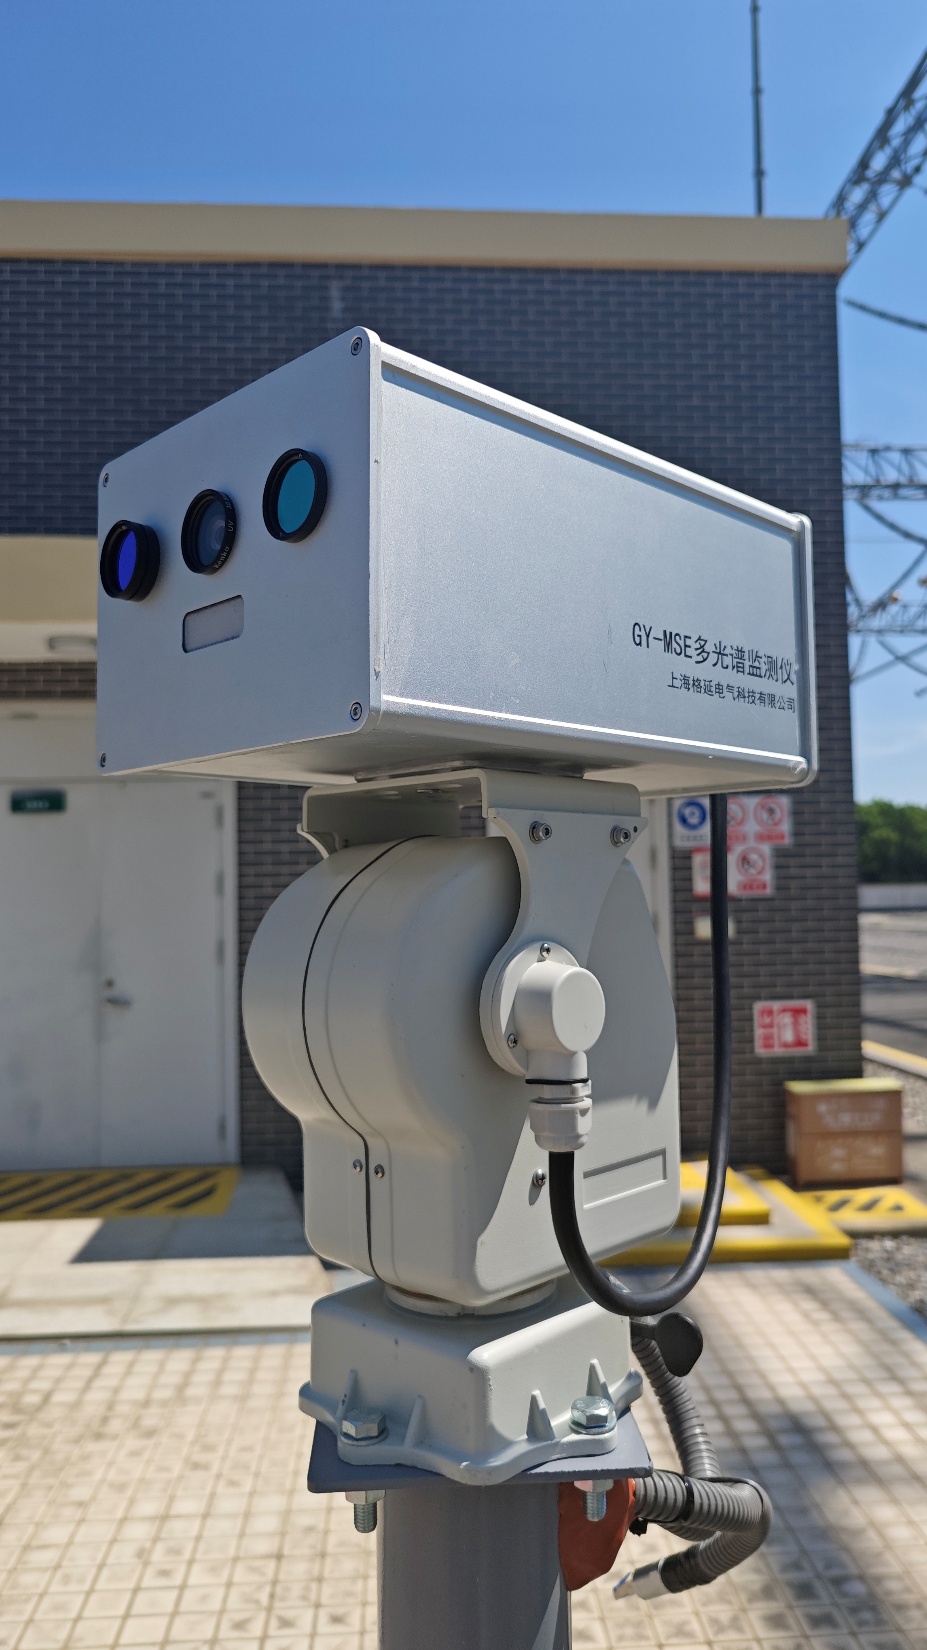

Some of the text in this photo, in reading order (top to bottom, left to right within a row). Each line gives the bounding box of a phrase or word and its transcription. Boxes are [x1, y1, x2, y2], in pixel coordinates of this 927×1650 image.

[213, 520, 234, 569] Kenko UV
[632, 622, 795, 686] GY-MSE多光谱监测仪
[667, 671, 796, 714] 上海格延电气科技有限公司
